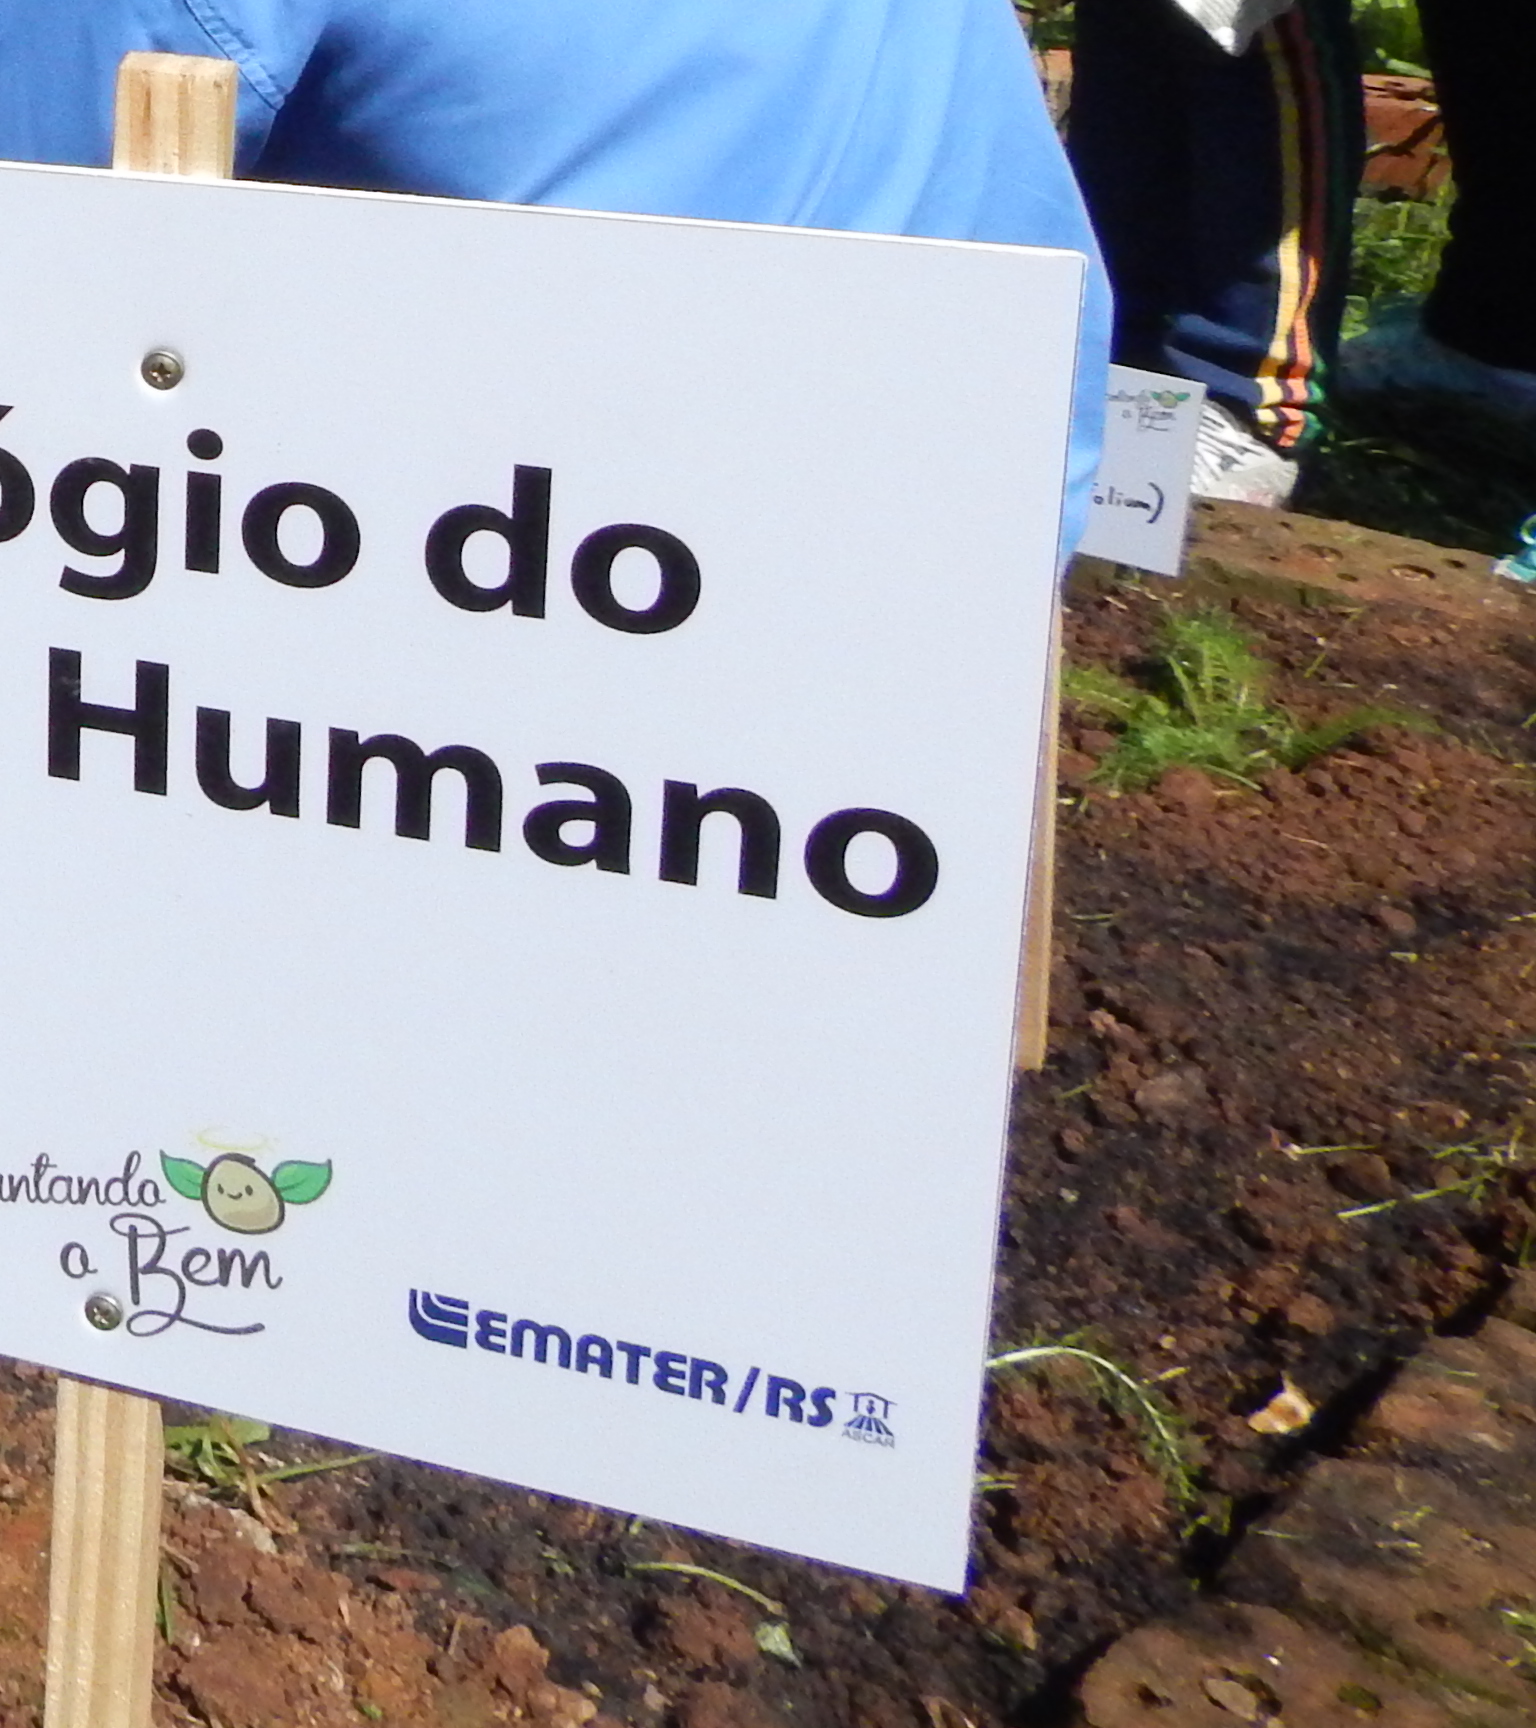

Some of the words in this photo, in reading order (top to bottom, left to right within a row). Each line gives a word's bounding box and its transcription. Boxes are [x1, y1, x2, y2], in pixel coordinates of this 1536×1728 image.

[424, 464, 703, 635] do
[47, 646, 940, 919] Humano
[109, 1212, 283, 1337] Bem
[474, 1309, 837, 1428] EMATER/RS
